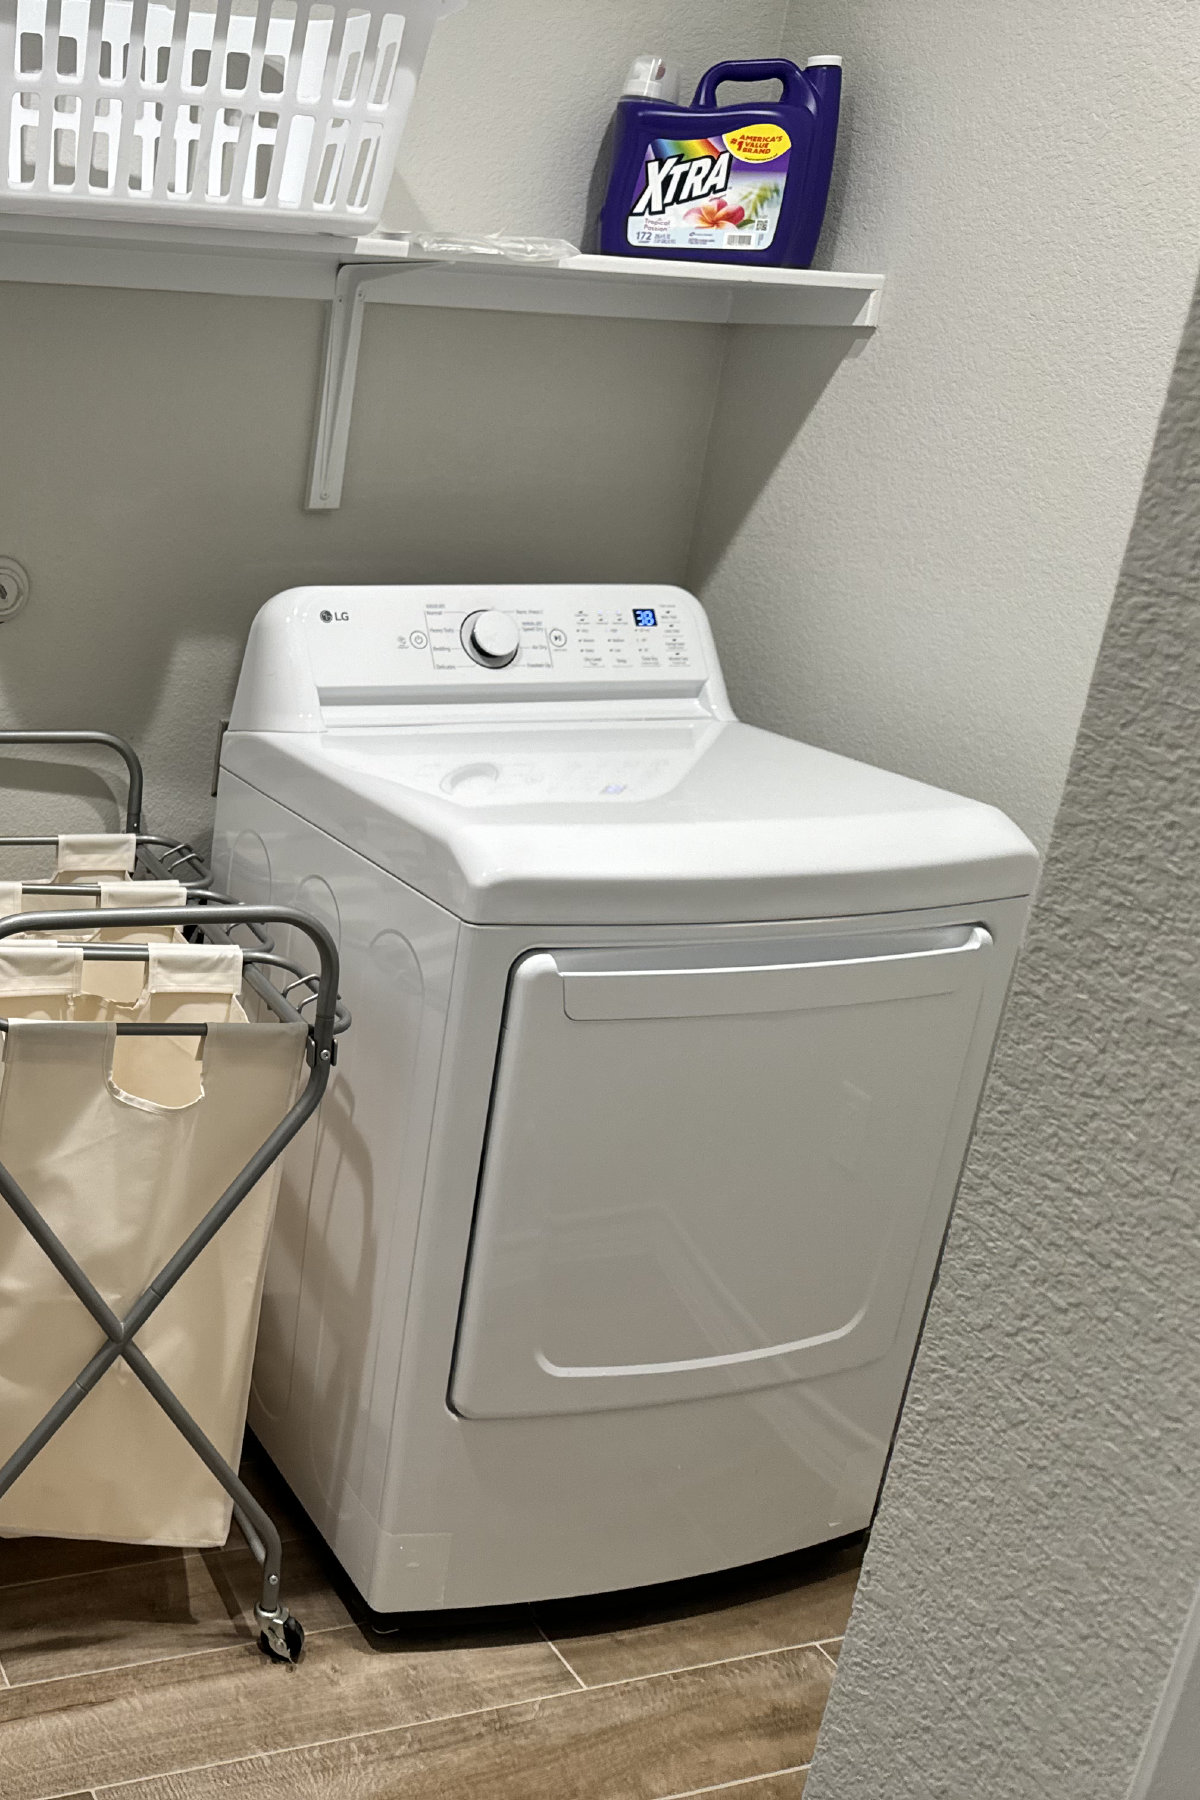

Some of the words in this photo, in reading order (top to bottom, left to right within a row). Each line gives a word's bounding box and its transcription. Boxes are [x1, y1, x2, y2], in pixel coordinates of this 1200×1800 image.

[739, 135, 783, 143] AMERICA'S
[629, 151, 732, 216] XTRA
[636, 231, 652, 240] 172
[335, 612, 350, 621] LG
[636, 610, 655, 626] 38
